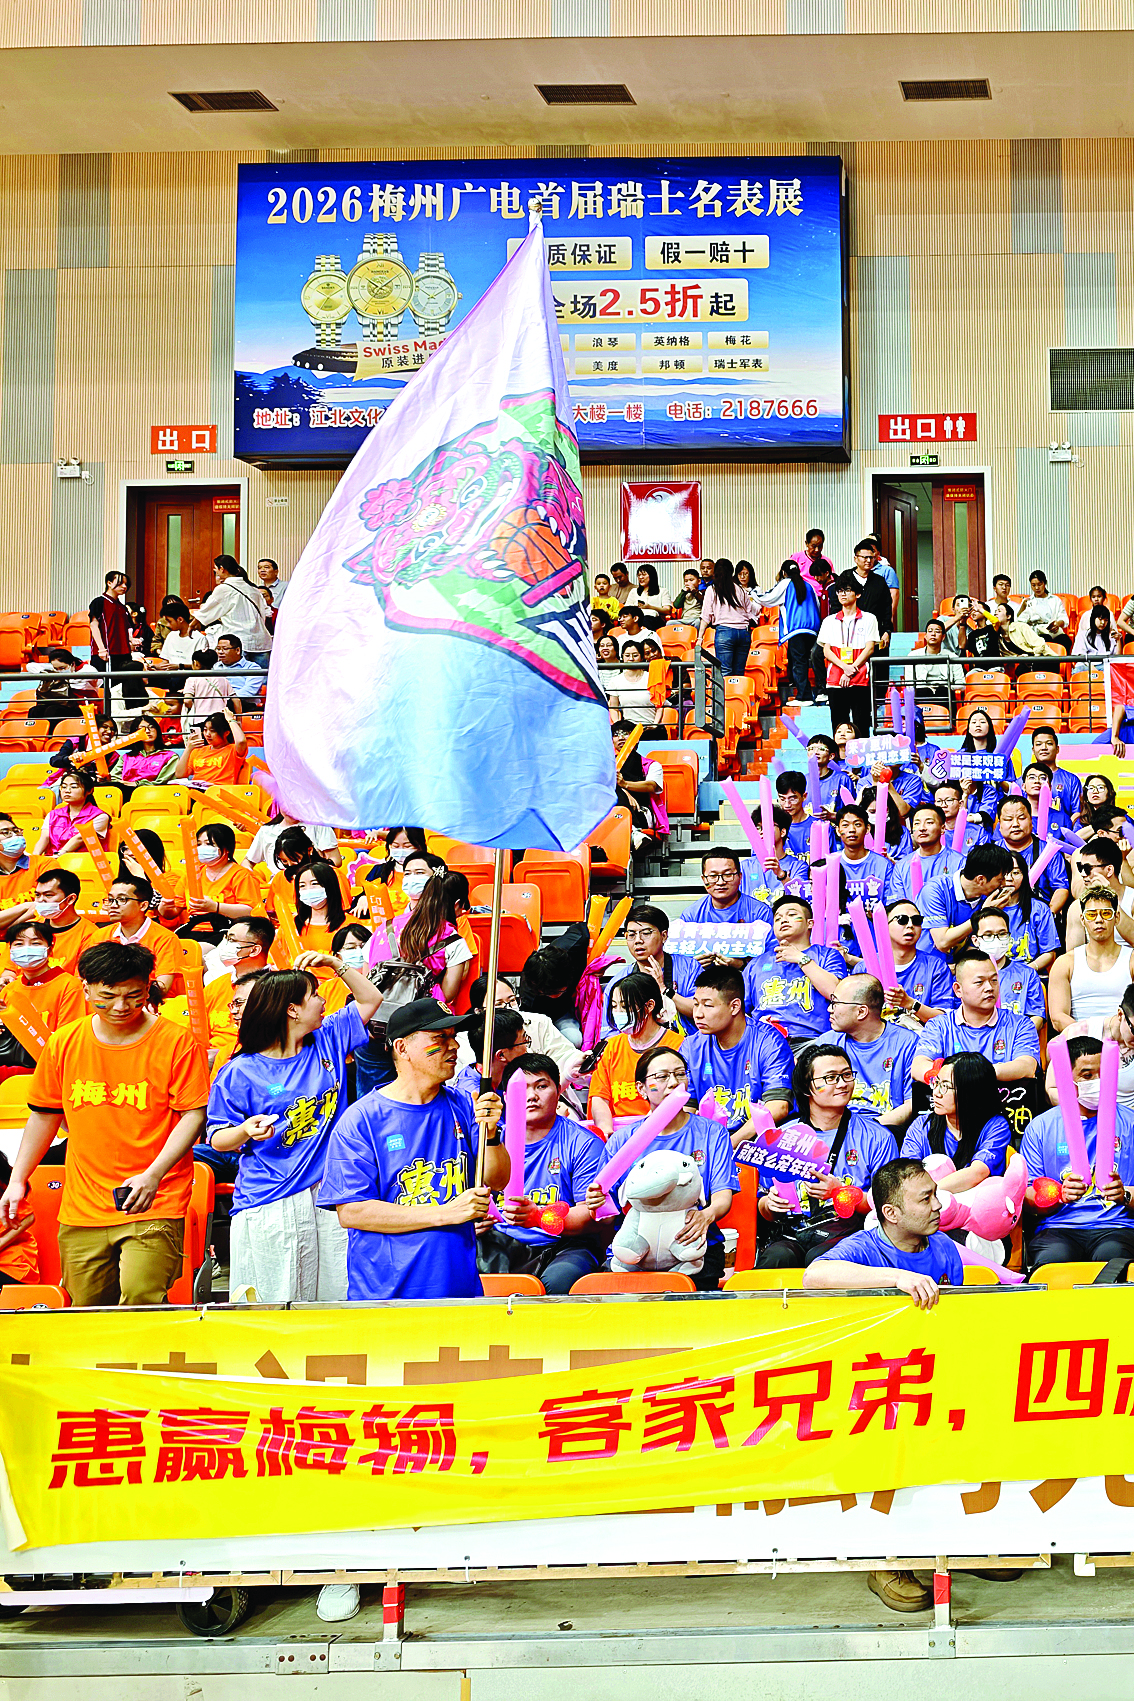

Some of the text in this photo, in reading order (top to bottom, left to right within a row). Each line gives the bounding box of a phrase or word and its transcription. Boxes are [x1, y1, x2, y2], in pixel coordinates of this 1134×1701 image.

[267, 178, 804, 224] 2026梅州广电首届瑞士名表展
[546, 243, 617, 266] 质保证
[660, 241, 755, 265] 假一赔十
[363, 338, 446, 358] Swiss Ma
[592, 337, 619, 347] 浪琴
[653, 335, 690, 346] 英纳格
[725, 335, 752, 345] 梅花
[381, 353, 433, 369] 原装进
[592, 360, 619, 371] 美度
[659, 359, 686, 370] 邦顿
[713, 358, 763, 369] 瑞士军表
[721, 399, 819, 420] 2187666
[889, 417, 937, 440] 出口
[157, 429, 210, 450] 出口
[664, 940, 764, 956] 年轻人的主场
[759, 975, 814, 1013] 惠州
[69, 1078, 149, 1111] 梅州
[777, 1128, 816, 1156] 惠州
[48, 1403, 490, 1490] 惠赢梅输，
[538, 1346, 967, 1463] 客家兄弟，
